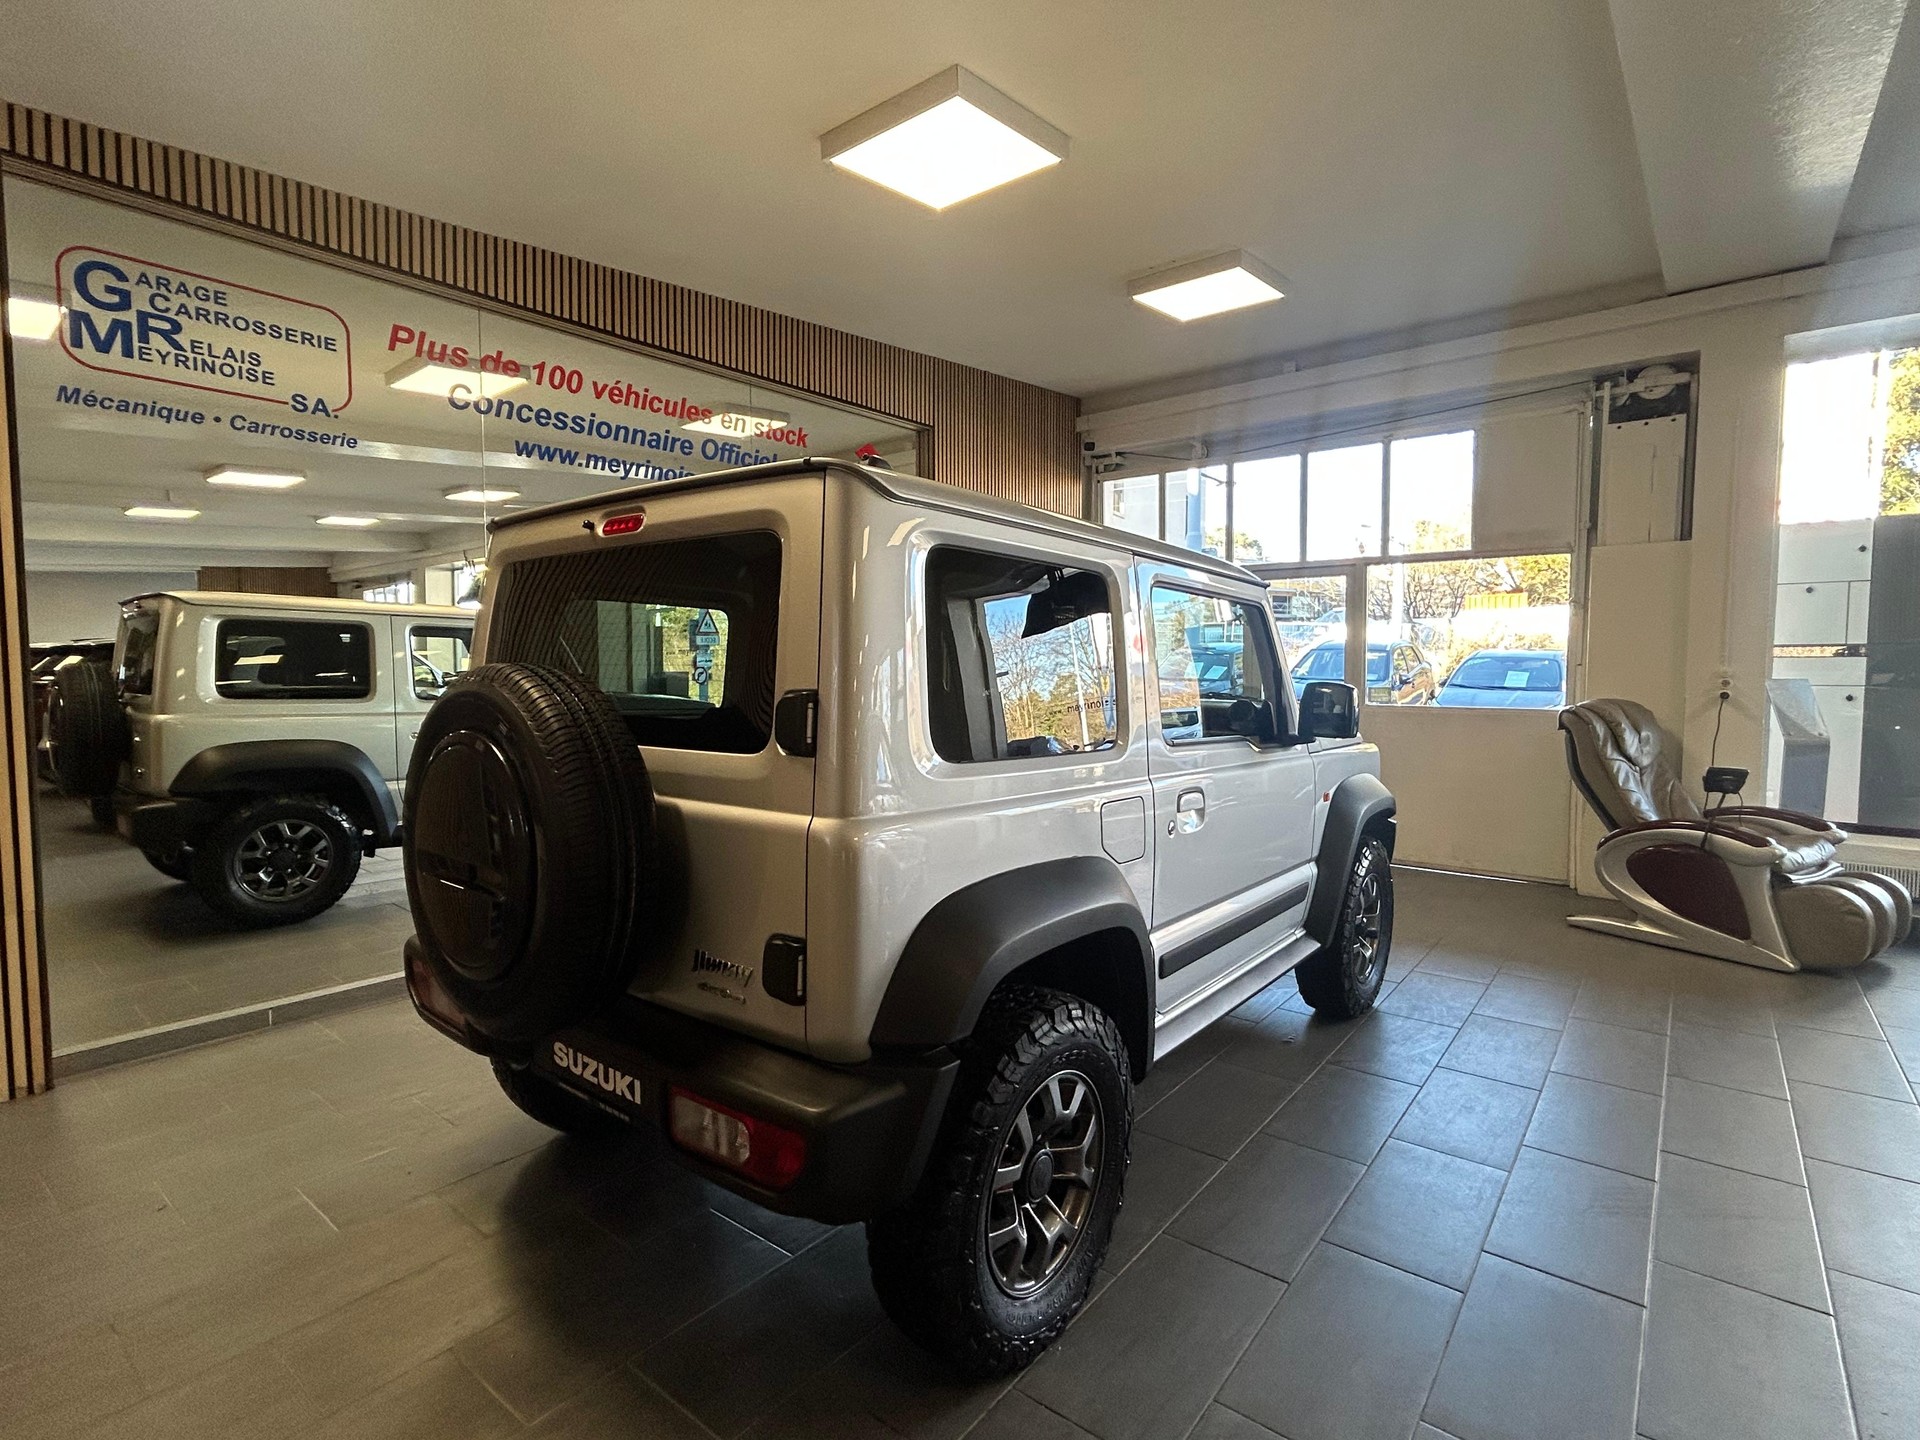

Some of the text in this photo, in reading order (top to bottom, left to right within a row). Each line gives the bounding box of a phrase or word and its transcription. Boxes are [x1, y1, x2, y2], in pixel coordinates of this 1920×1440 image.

[73, 260, 228, 312] GARAGE
[69, 308, 275, 386] MEYRINOISE
[136, 309, 262, 368] RELAIS
[148, 292, 337, 352] CARROSSERIE
[56, 384, 358, 449] Mécanique Carrosserie
[388, 323, 808, 448] Plus de 100 véhicules en stock
[447, 383, 694, 456] Concessionnaire
[553, 1041, 641, 1105] SUZUKI
